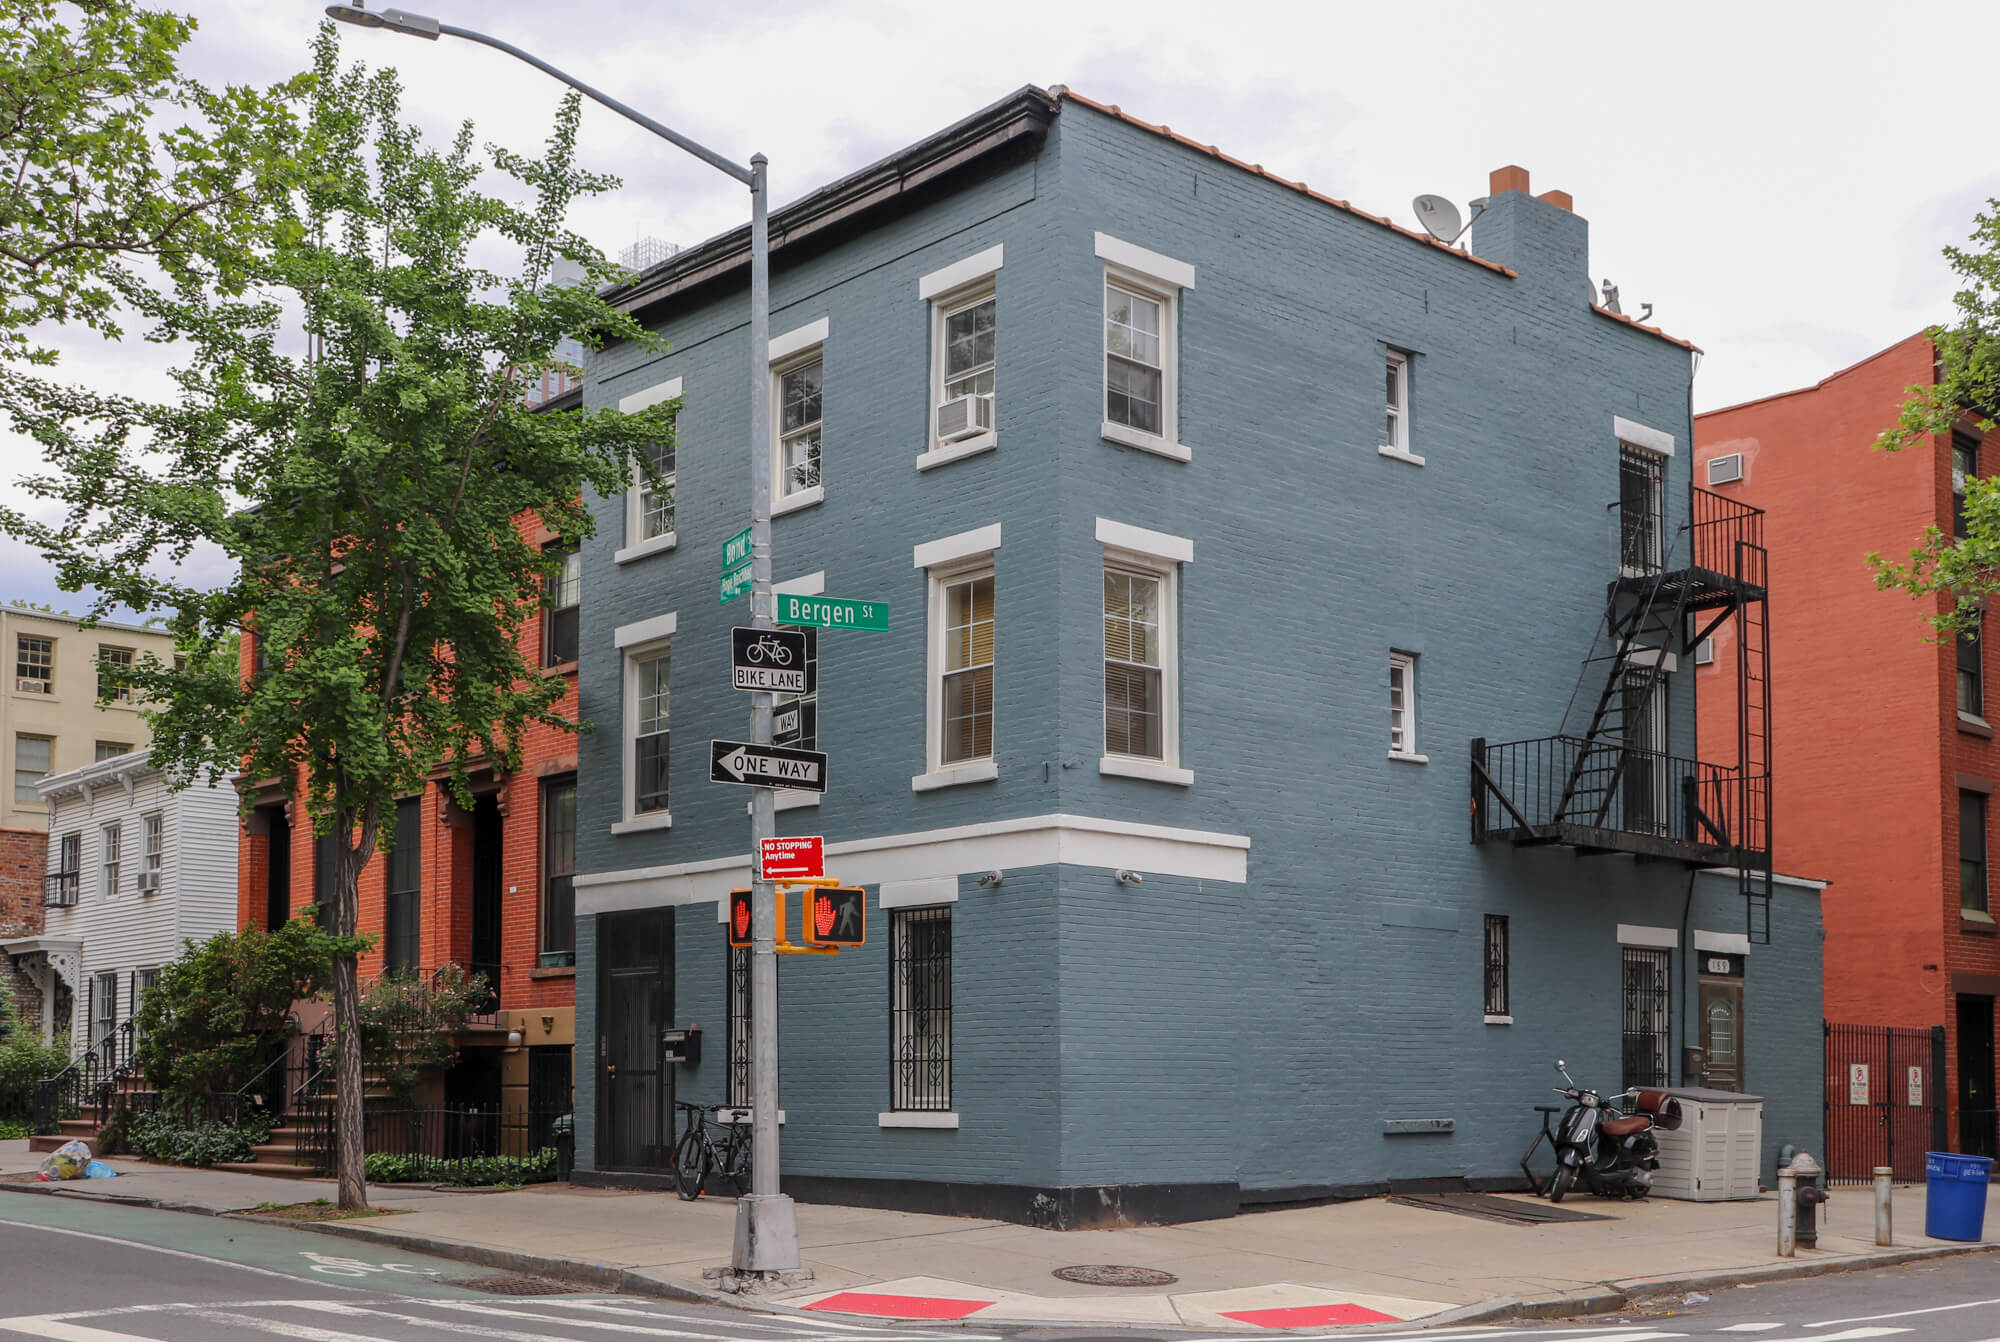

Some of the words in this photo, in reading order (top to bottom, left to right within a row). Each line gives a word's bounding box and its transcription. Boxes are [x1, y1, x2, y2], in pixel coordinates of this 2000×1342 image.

[727, 533, 746, 566] Bond
[789, 598, 855, 627] Bergen
[862, 604, 873, 618] St
[737, 669, 765, 686] BIKE
[771, 672, 802, 689] LANE
[780, 711, 796, 732] WAY
[734, 756, 769, 773] ONE
[778, 762, 811, 778] WAY
[764, 842, 775, 851] NO
[776, 841, 813, 850] STOPPING
[765, 851, 796, 861] Anytime
